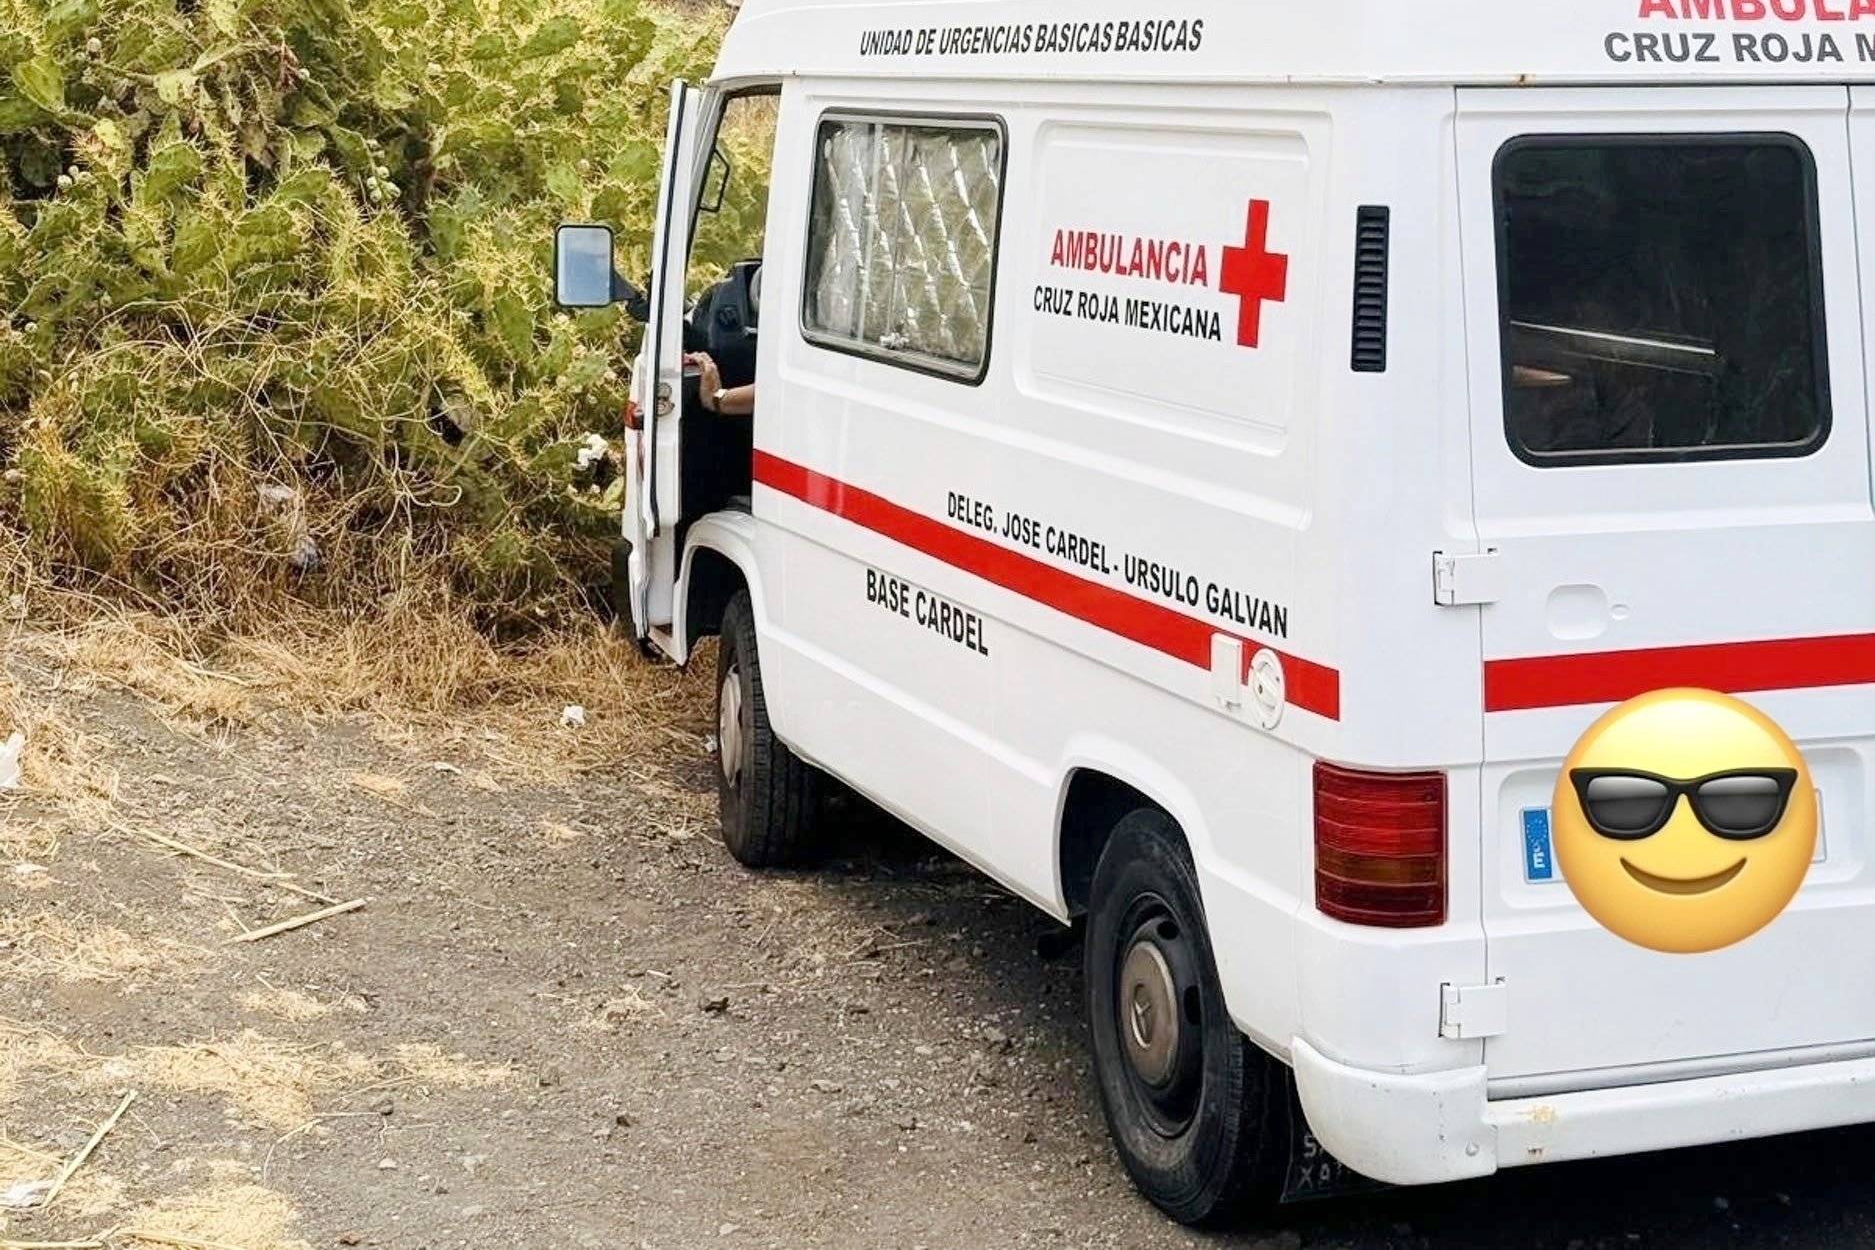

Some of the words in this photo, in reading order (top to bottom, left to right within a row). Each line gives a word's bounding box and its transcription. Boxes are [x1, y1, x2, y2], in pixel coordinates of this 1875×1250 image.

[860, 29, 913, 56] UNIDAD
[915, 28, 937, 55] DE
[939, 24, 1033, 55] URGENCIAS
[1034, 22, 1114, 53] BASICAS
[1114, 19, 1204, 52] BASICAS
[1604, 32, 1720, 62] CRUZ
[1732, 32, 1844, 62] ROJA
[1050, 228, 1208, 287] AMBULANCIA
[1033, 285, 1074, 317] CRUZ
[1077, 291, 1120, 324] ROJA
[1124, 297, 1222, 342] MEXICANA
[947, 491, 998, 534] DELEG.
[1002, 512, 1041, 549] JOSE
[1046, 526, 1111, 575] CARDEL
[1124, 553, 1199, 607] URSULO
[1205, 582, 1288, 639] GALVAN
[866, 568, 910, 618] BASE
[915, 590, 989, 657] CARDEL
